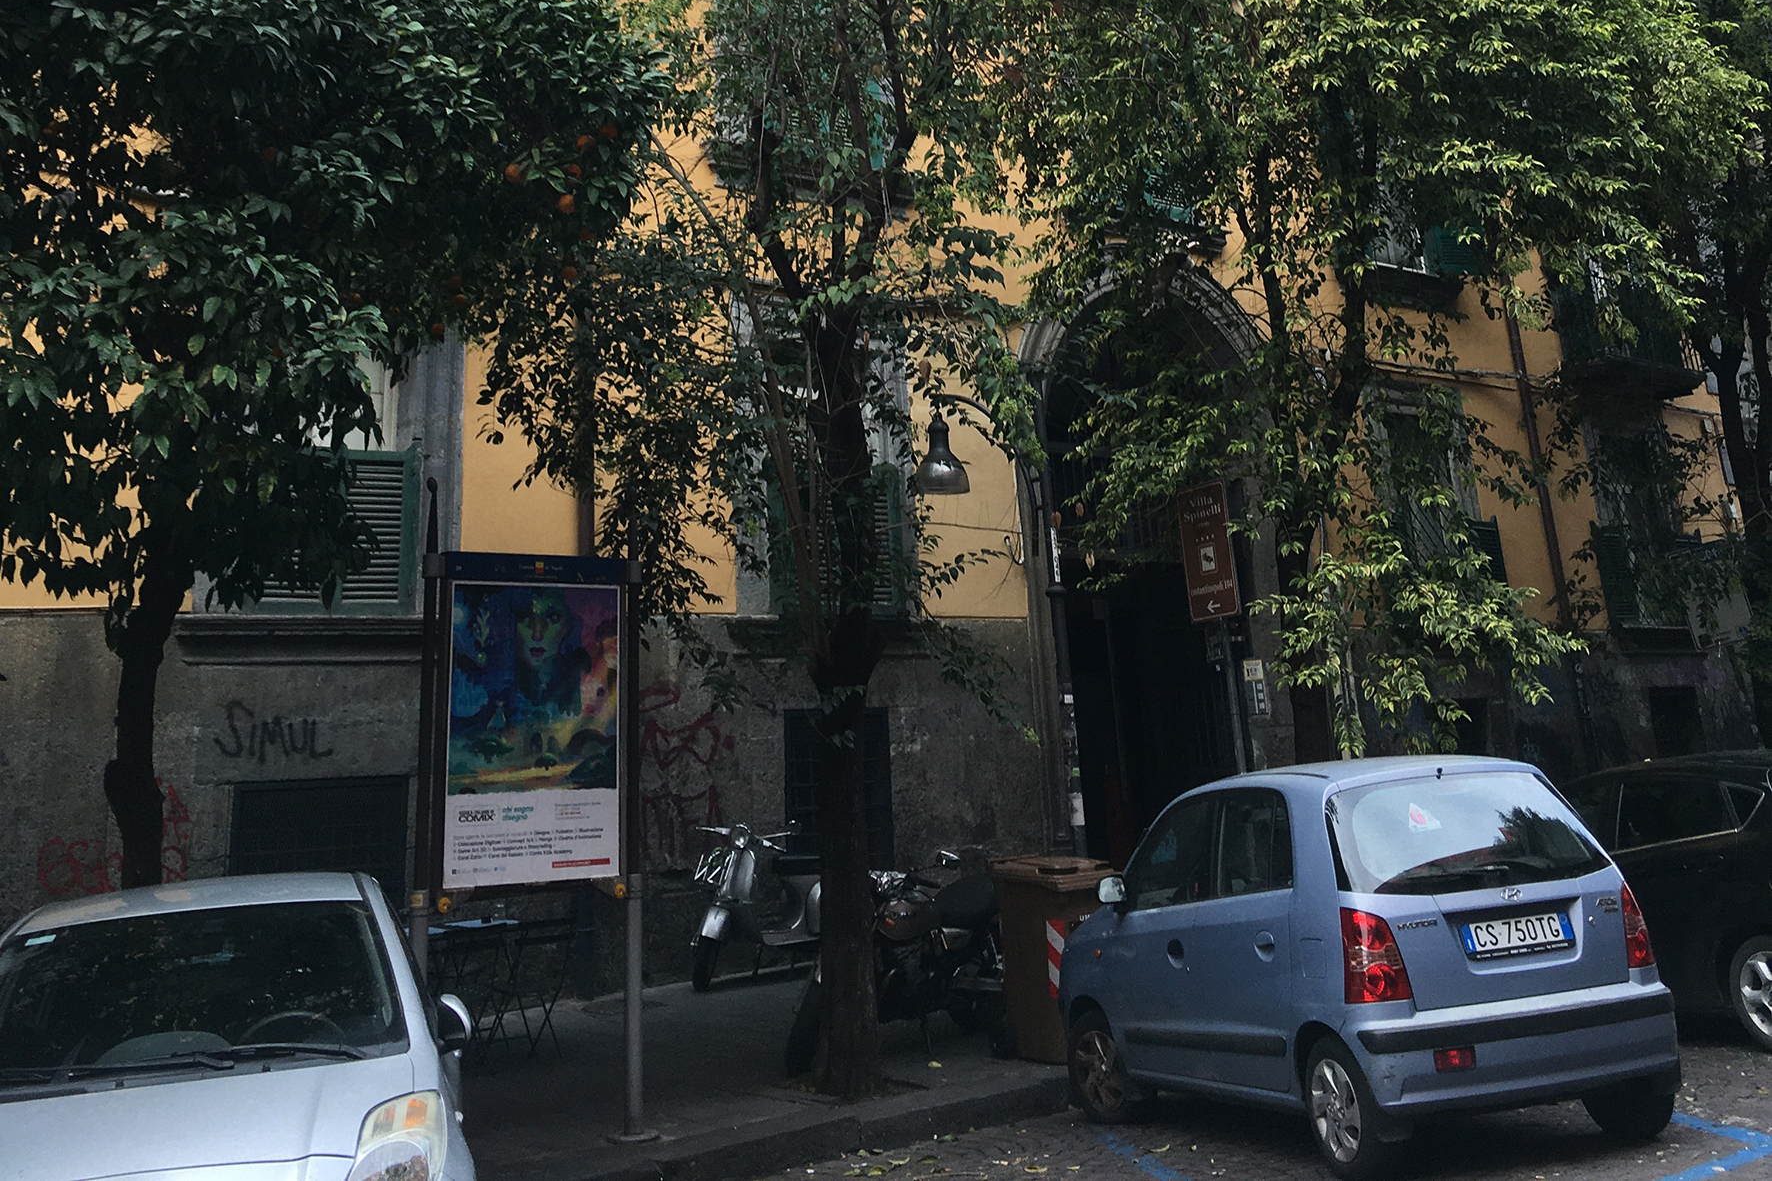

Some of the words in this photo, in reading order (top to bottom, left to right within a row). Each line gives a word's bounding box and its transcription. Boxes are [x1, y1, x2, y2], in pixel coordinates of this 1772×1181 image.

[1189, 496, 1213, 508] Villa
[1183, 503, 1221, 523] Spinelli
[212, 701, 334, 766] SIMUL
[458, 814, 494, 823] COMIX
[1397, 918, 1438, 931] HYUNDAI
[1474, 923, 1499, 948] CS
[1501, 916, 1560, 944] 750TG
